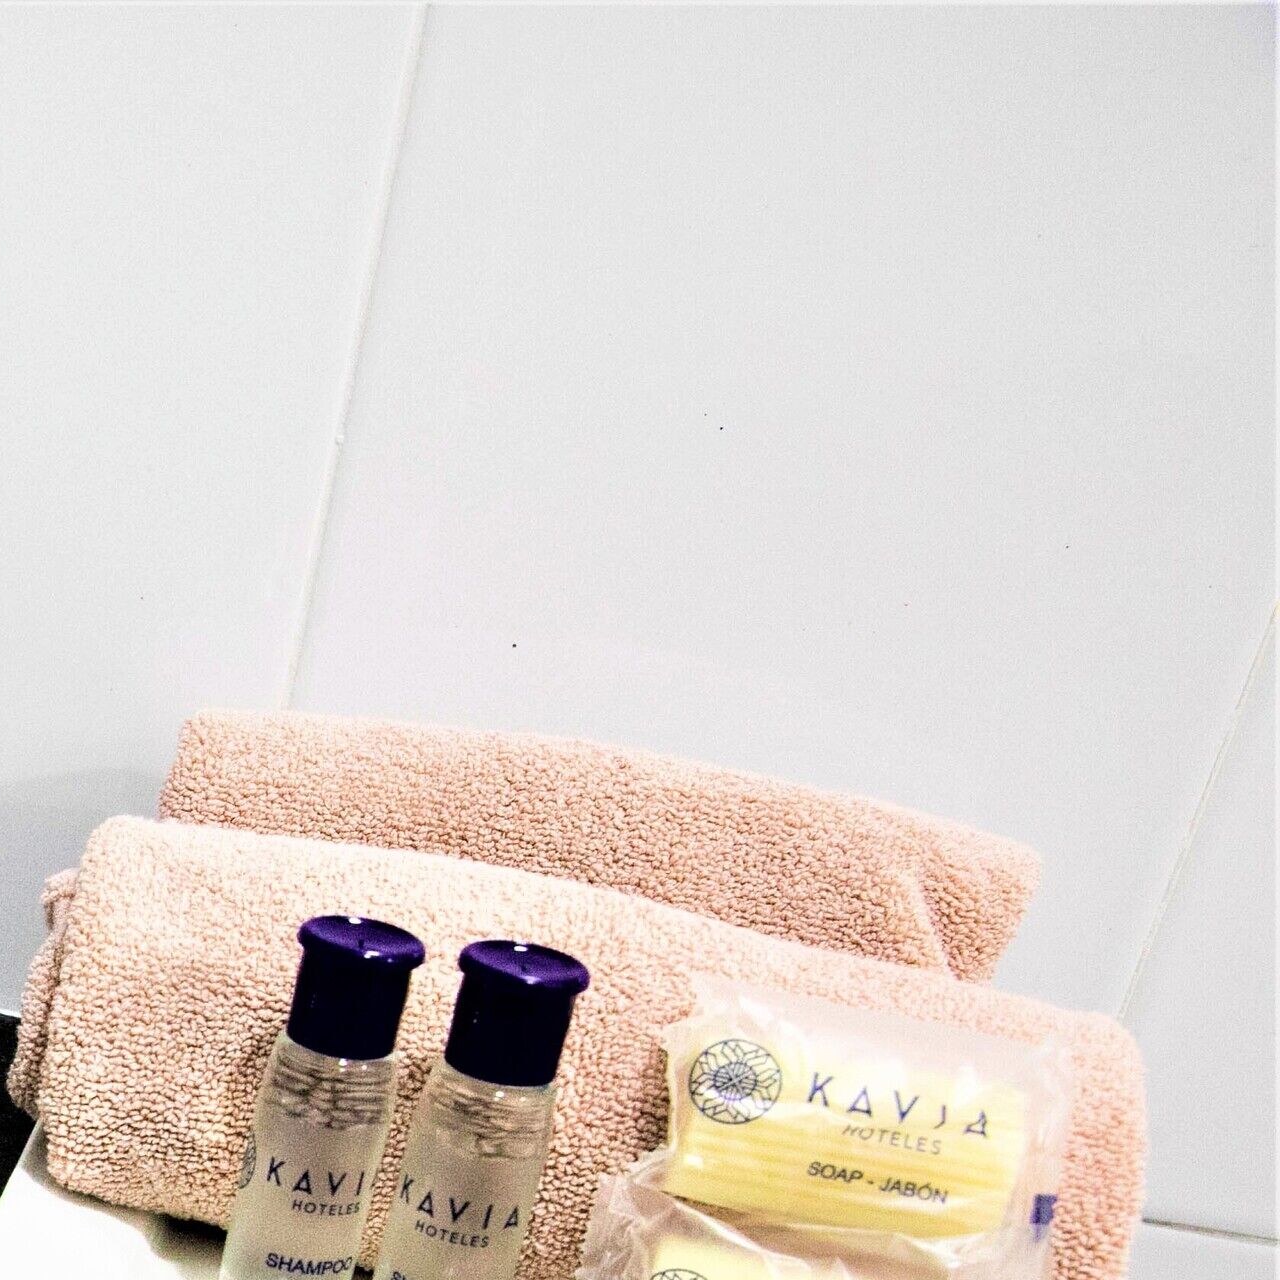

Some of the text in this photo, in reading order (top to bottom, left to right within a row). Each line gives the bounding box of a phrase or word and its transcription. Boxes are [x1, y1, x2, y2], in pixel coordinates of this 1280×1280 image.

[807, 1072, 988, 1138] KAVIA
[842, 1124, 942, 1155] HOTELES
[266, 1156, 365, 1197] KAVI
[807, 1161, 863, 1184] SOAP
[879, 1178, 948, 1204] JABÓN
[292, 1200, 360, 1216] HOTELES
[400, 1174, 519, 1230] KAVIA
[414, 1220, 489, 1248] HOTELES
[265, 1252, 353, 1275] SHAMPOO
